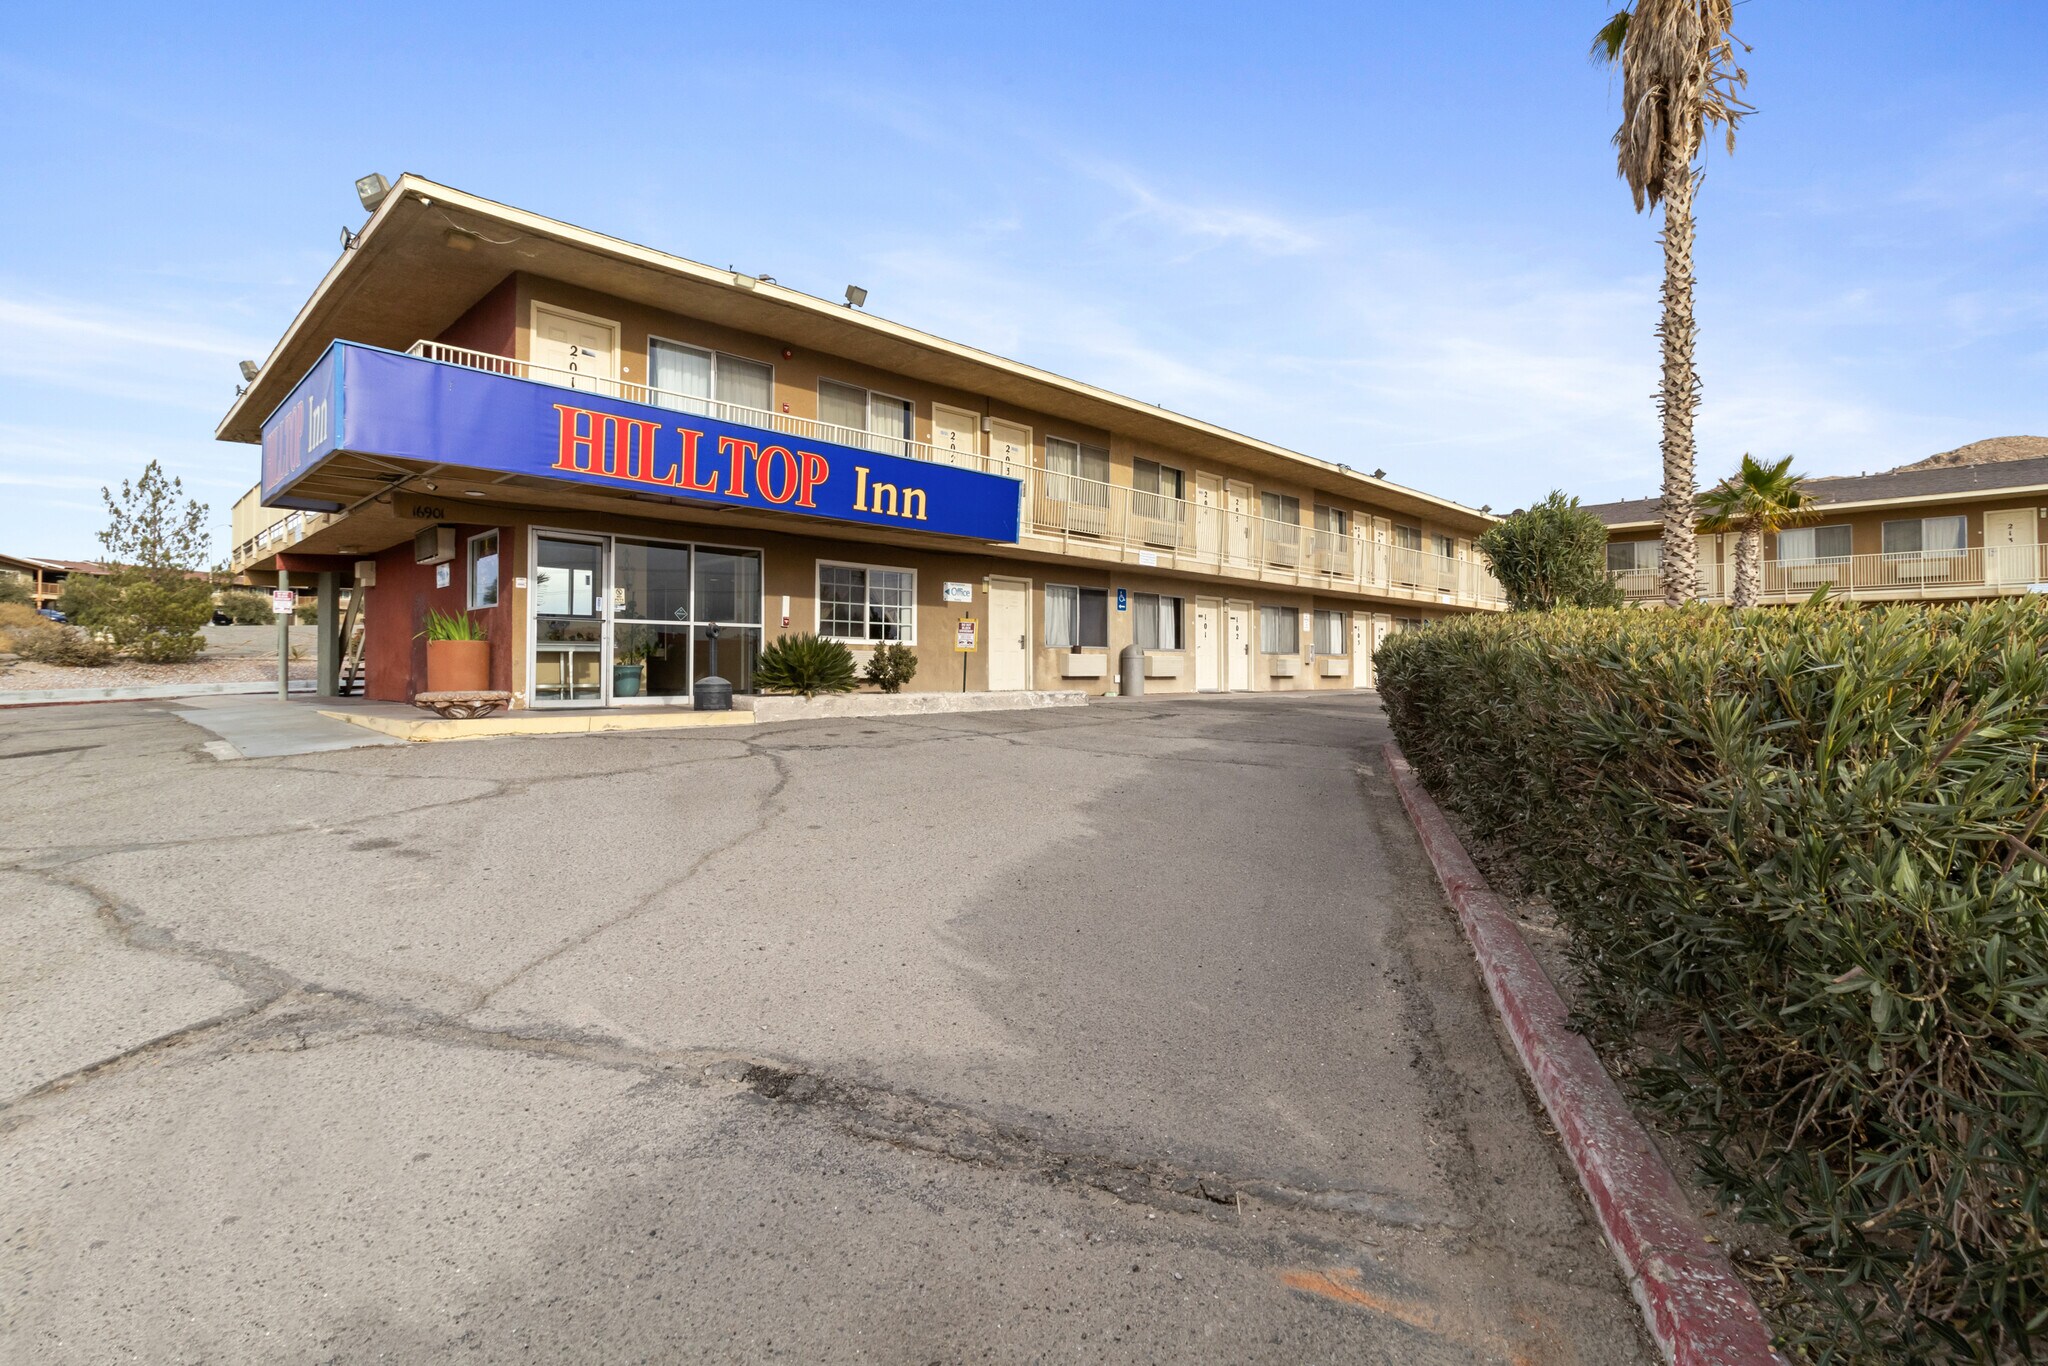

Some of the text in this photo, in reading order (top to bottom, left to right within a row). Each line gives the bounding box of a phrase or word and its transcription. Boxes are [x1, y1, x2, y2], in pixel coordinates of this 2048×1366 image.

[308, 395, 328, 453] Inn
[552, 403, 928, 521] HILLTOP Inn
[412, 505, 445, 519] 16901
[950, 587, 970, 597] Office
